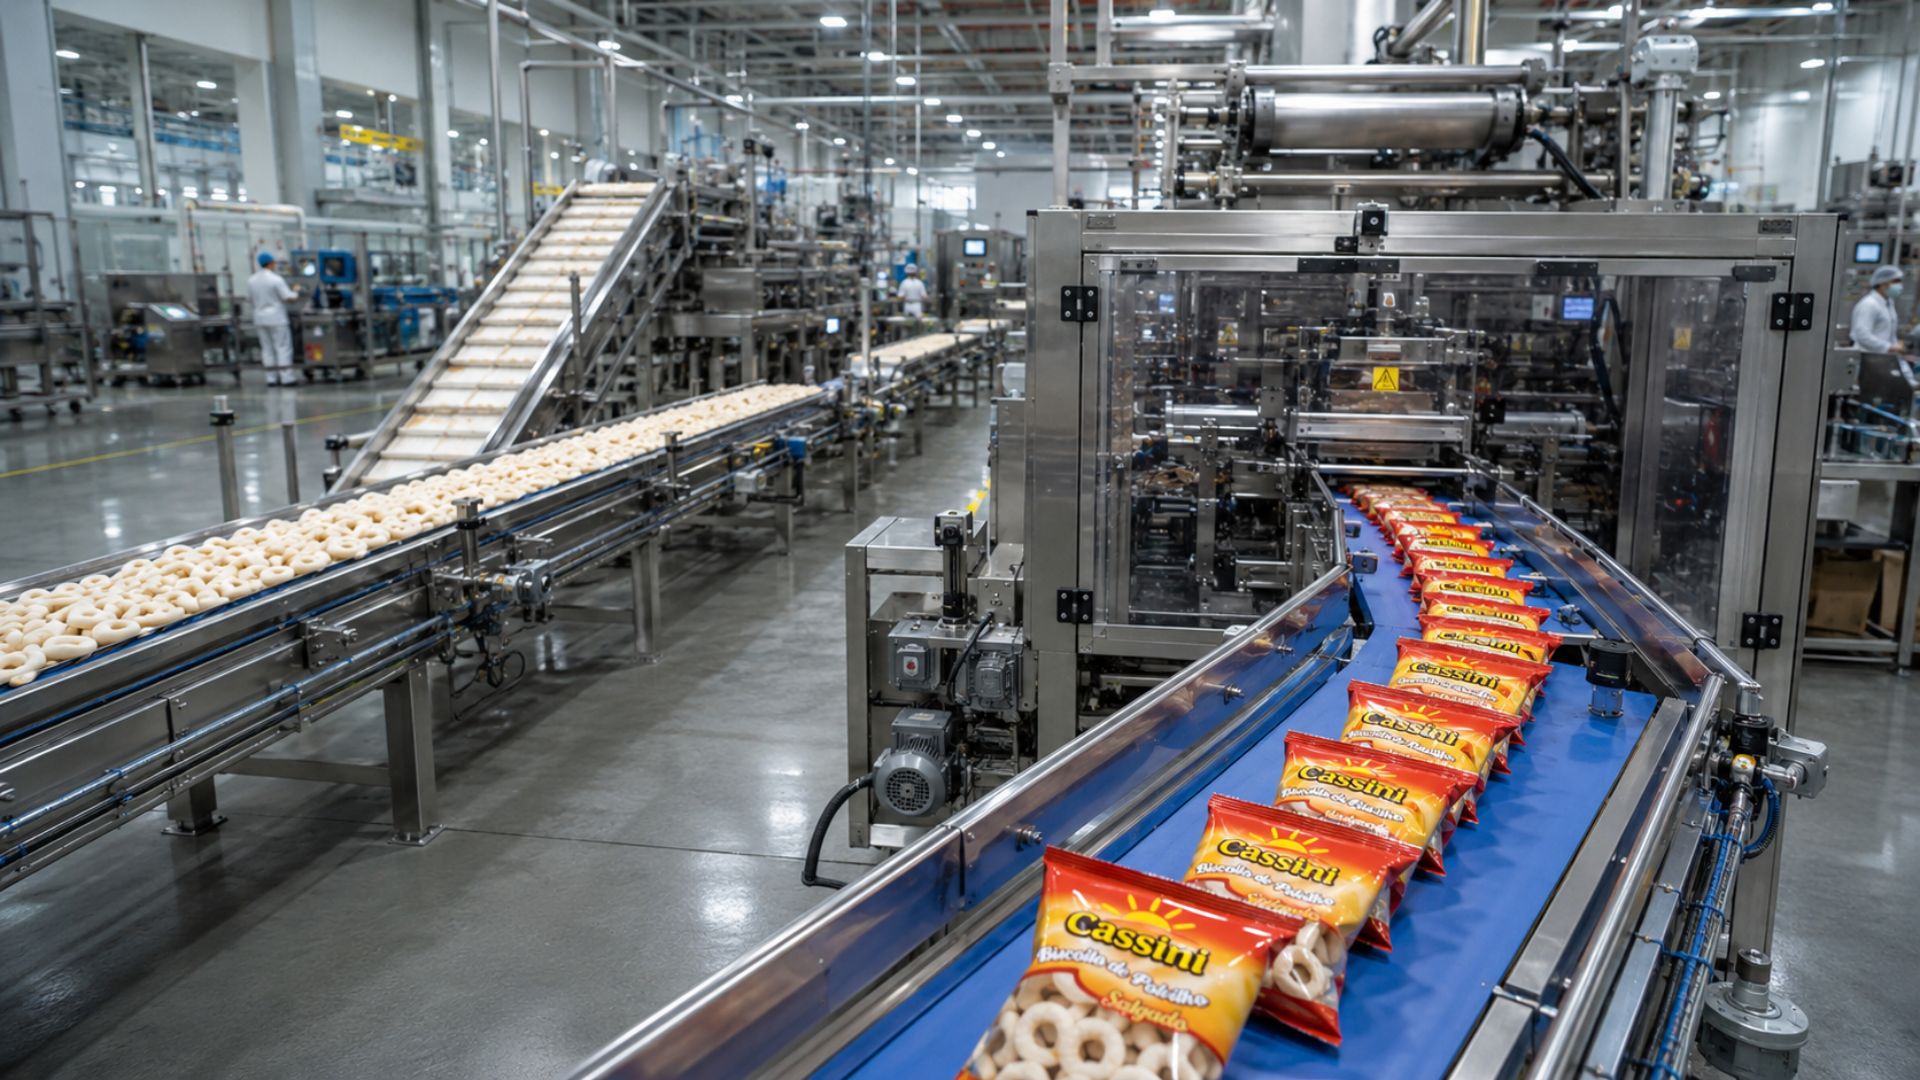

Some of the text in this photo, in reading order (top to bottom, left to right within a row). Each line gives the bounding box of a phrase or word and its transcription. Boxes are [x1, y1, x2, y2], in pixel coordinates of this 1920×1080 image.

[1409, 661, 1500, 690] Cassini
[1361, 711, 1460, 746] Cassini
[1298, 765, 1408, 805] Cassini
[1217, 838, 1341, 886] Cassini
[1065, 911, 1211, 977] Cassini
[1100, 990, 1188, 1032] Salgado
